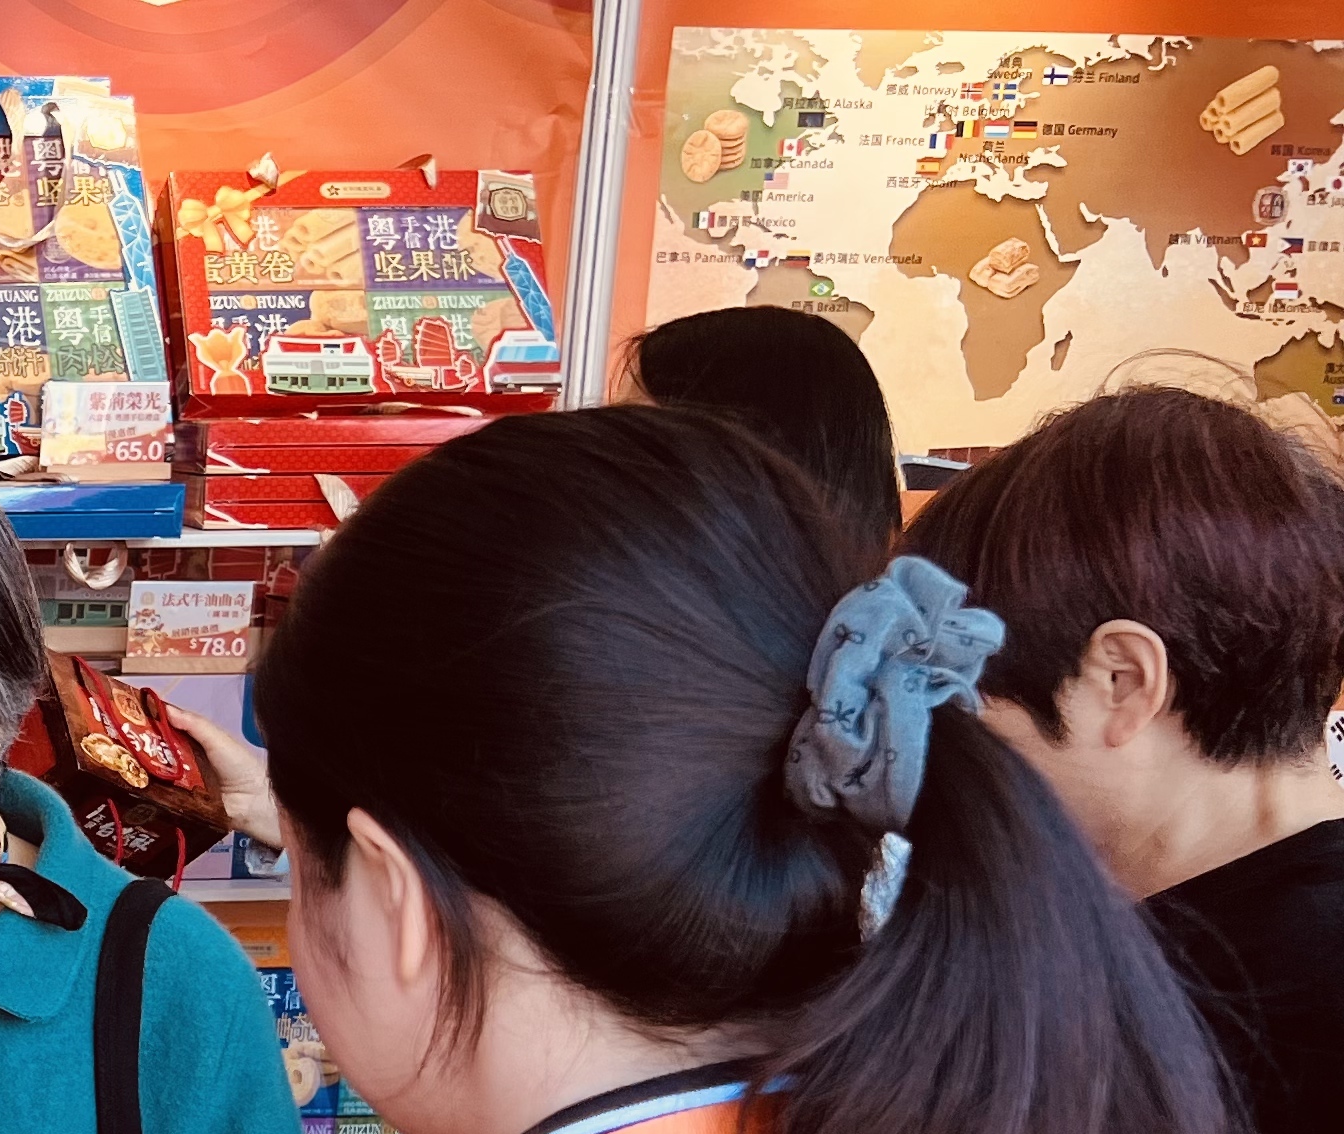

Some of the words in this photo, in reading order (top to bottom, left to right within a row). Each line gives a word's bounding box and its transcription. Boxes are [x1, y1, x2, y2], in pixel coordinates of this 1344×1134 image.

[1099, 73, 1140, 84] Finland
[913, 85, 958, 98] Norway
[833, 98, 872, 110] Alaska
[1068, 125, 1118, 138] Germany
[886, 135, 925, 146] France
[766, 191, 814, 203] America
[256, 295, 306, 309] HUANG
[373, 296, 423, 310] ZHIZUN
[437, 295, 486, 309] HUANG
[189, 637, 246, 657] $78.0
